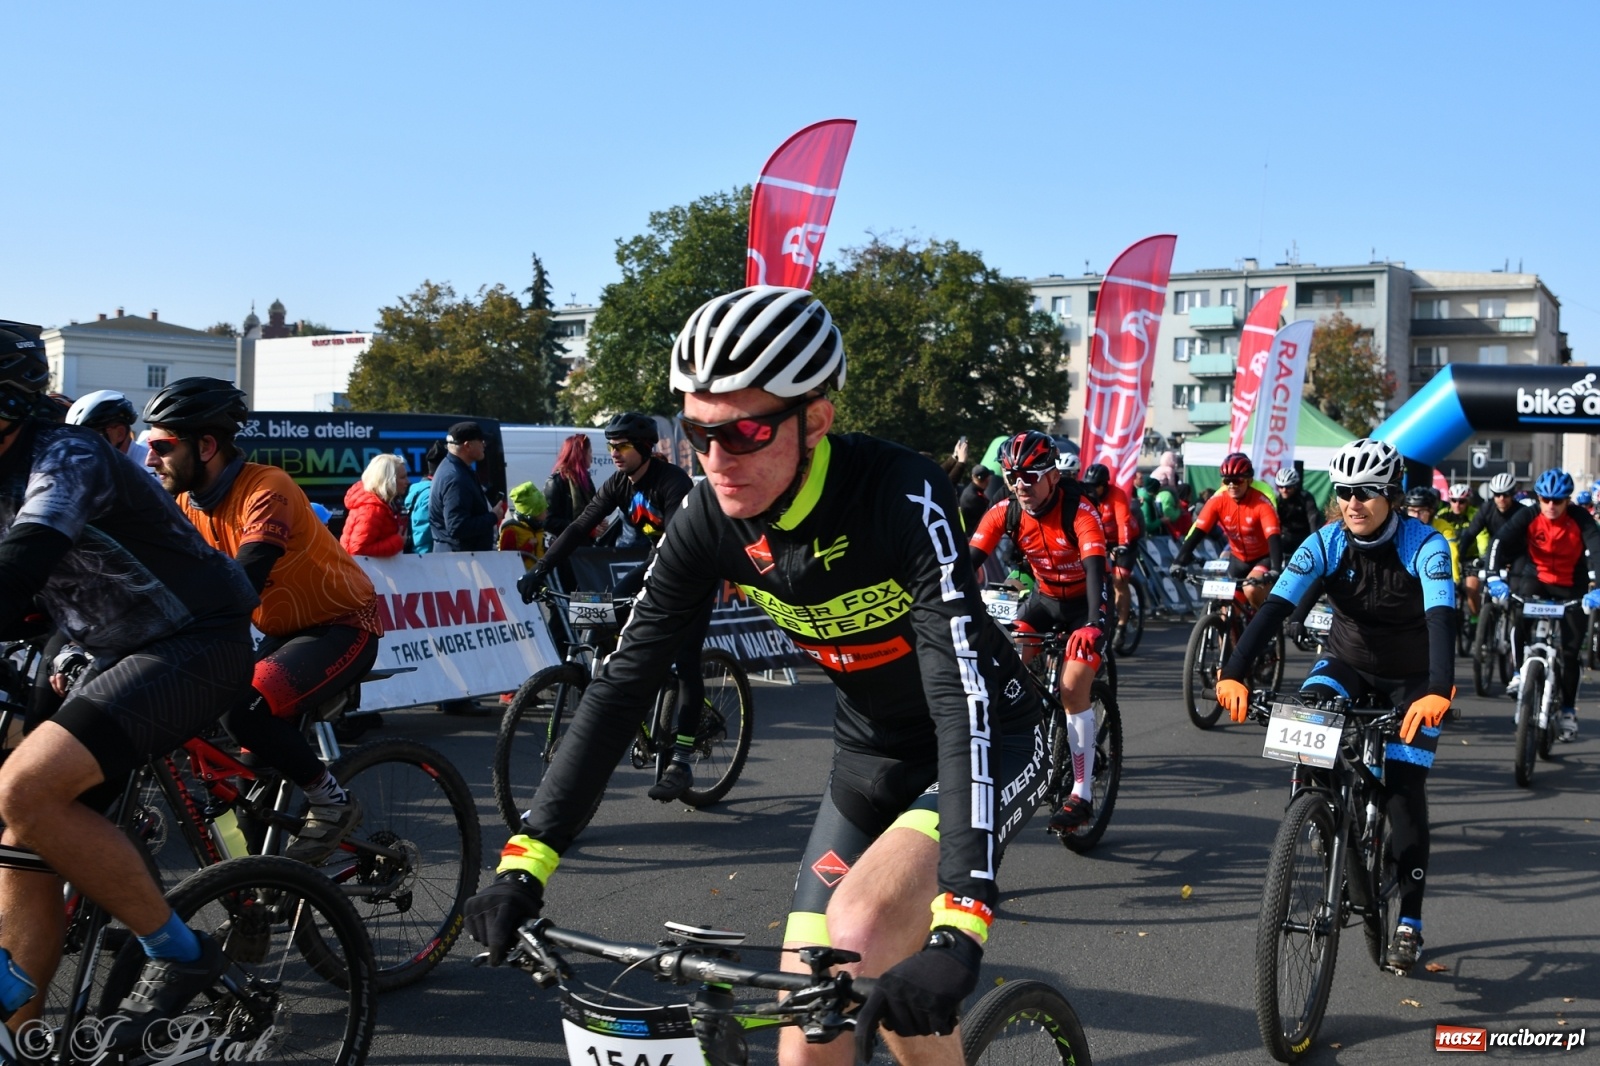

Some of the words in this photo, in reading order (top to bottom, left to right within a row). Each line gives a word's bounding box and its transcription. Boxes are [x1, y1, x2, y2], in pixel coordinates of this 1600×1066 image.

[1261, 340, 1298, 479] RACIBÓR
[1517, 387, 1576, 415] bike
[268, 420, 309, 438] bike
[314, 420, 373, 438] atelier
[905, 479, 965, 602] FOX
[376, 587, 508, 632] AKIMA
[811, 597, 911, 637] TEAM
[842, 584, 898, 611] FOX
[1310, 614, 1332, 626] 136
[391, 640, 433, 665] TAKE
[432, 631, 477, 657] MORE
[476, 620, 535, 649] FRIENDS
[950, 614, 994, 880] LEADER
[1279, 727, 1326, 750] 1418
[428, 914, 463, 963] MAXXIS
